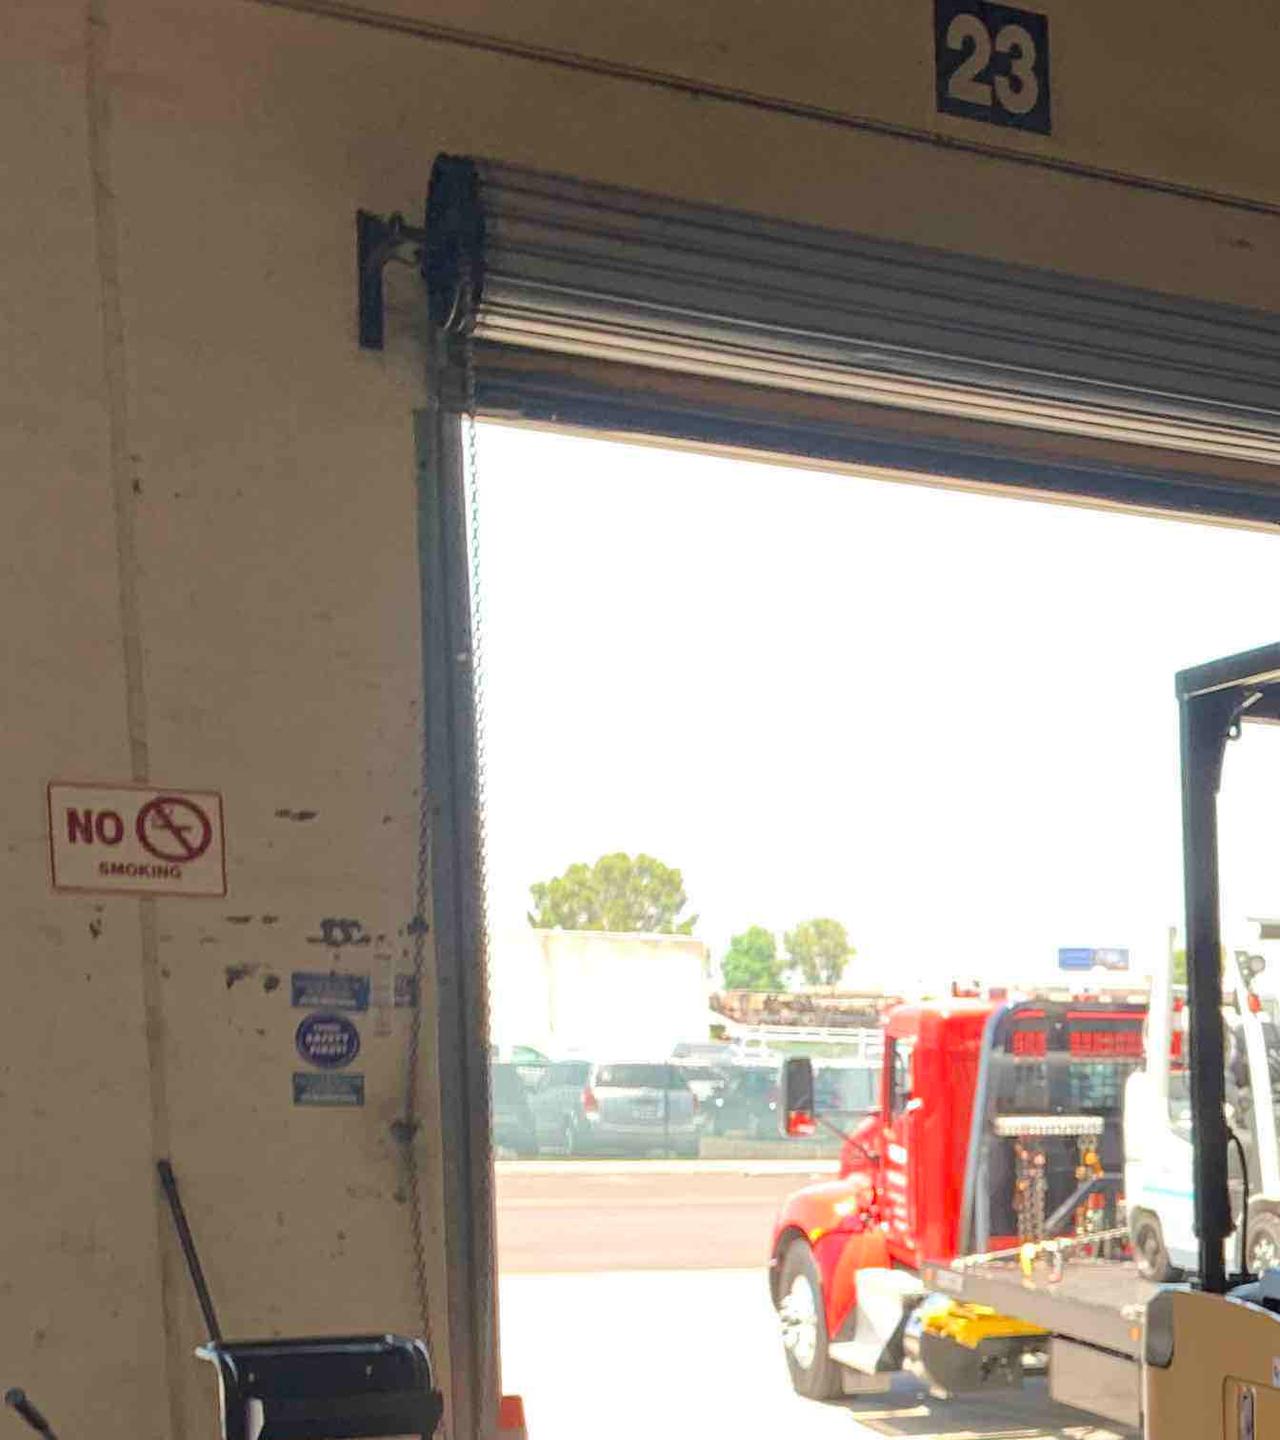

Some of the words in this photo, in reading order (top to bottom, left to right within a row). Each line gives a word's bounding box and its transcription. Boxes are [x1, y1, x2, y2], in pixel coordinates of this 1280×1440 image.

[946, 13, 1039, 114] 23
[66, 807, 124, 846] NO
[99, 859, 182, 880] SMOKING
